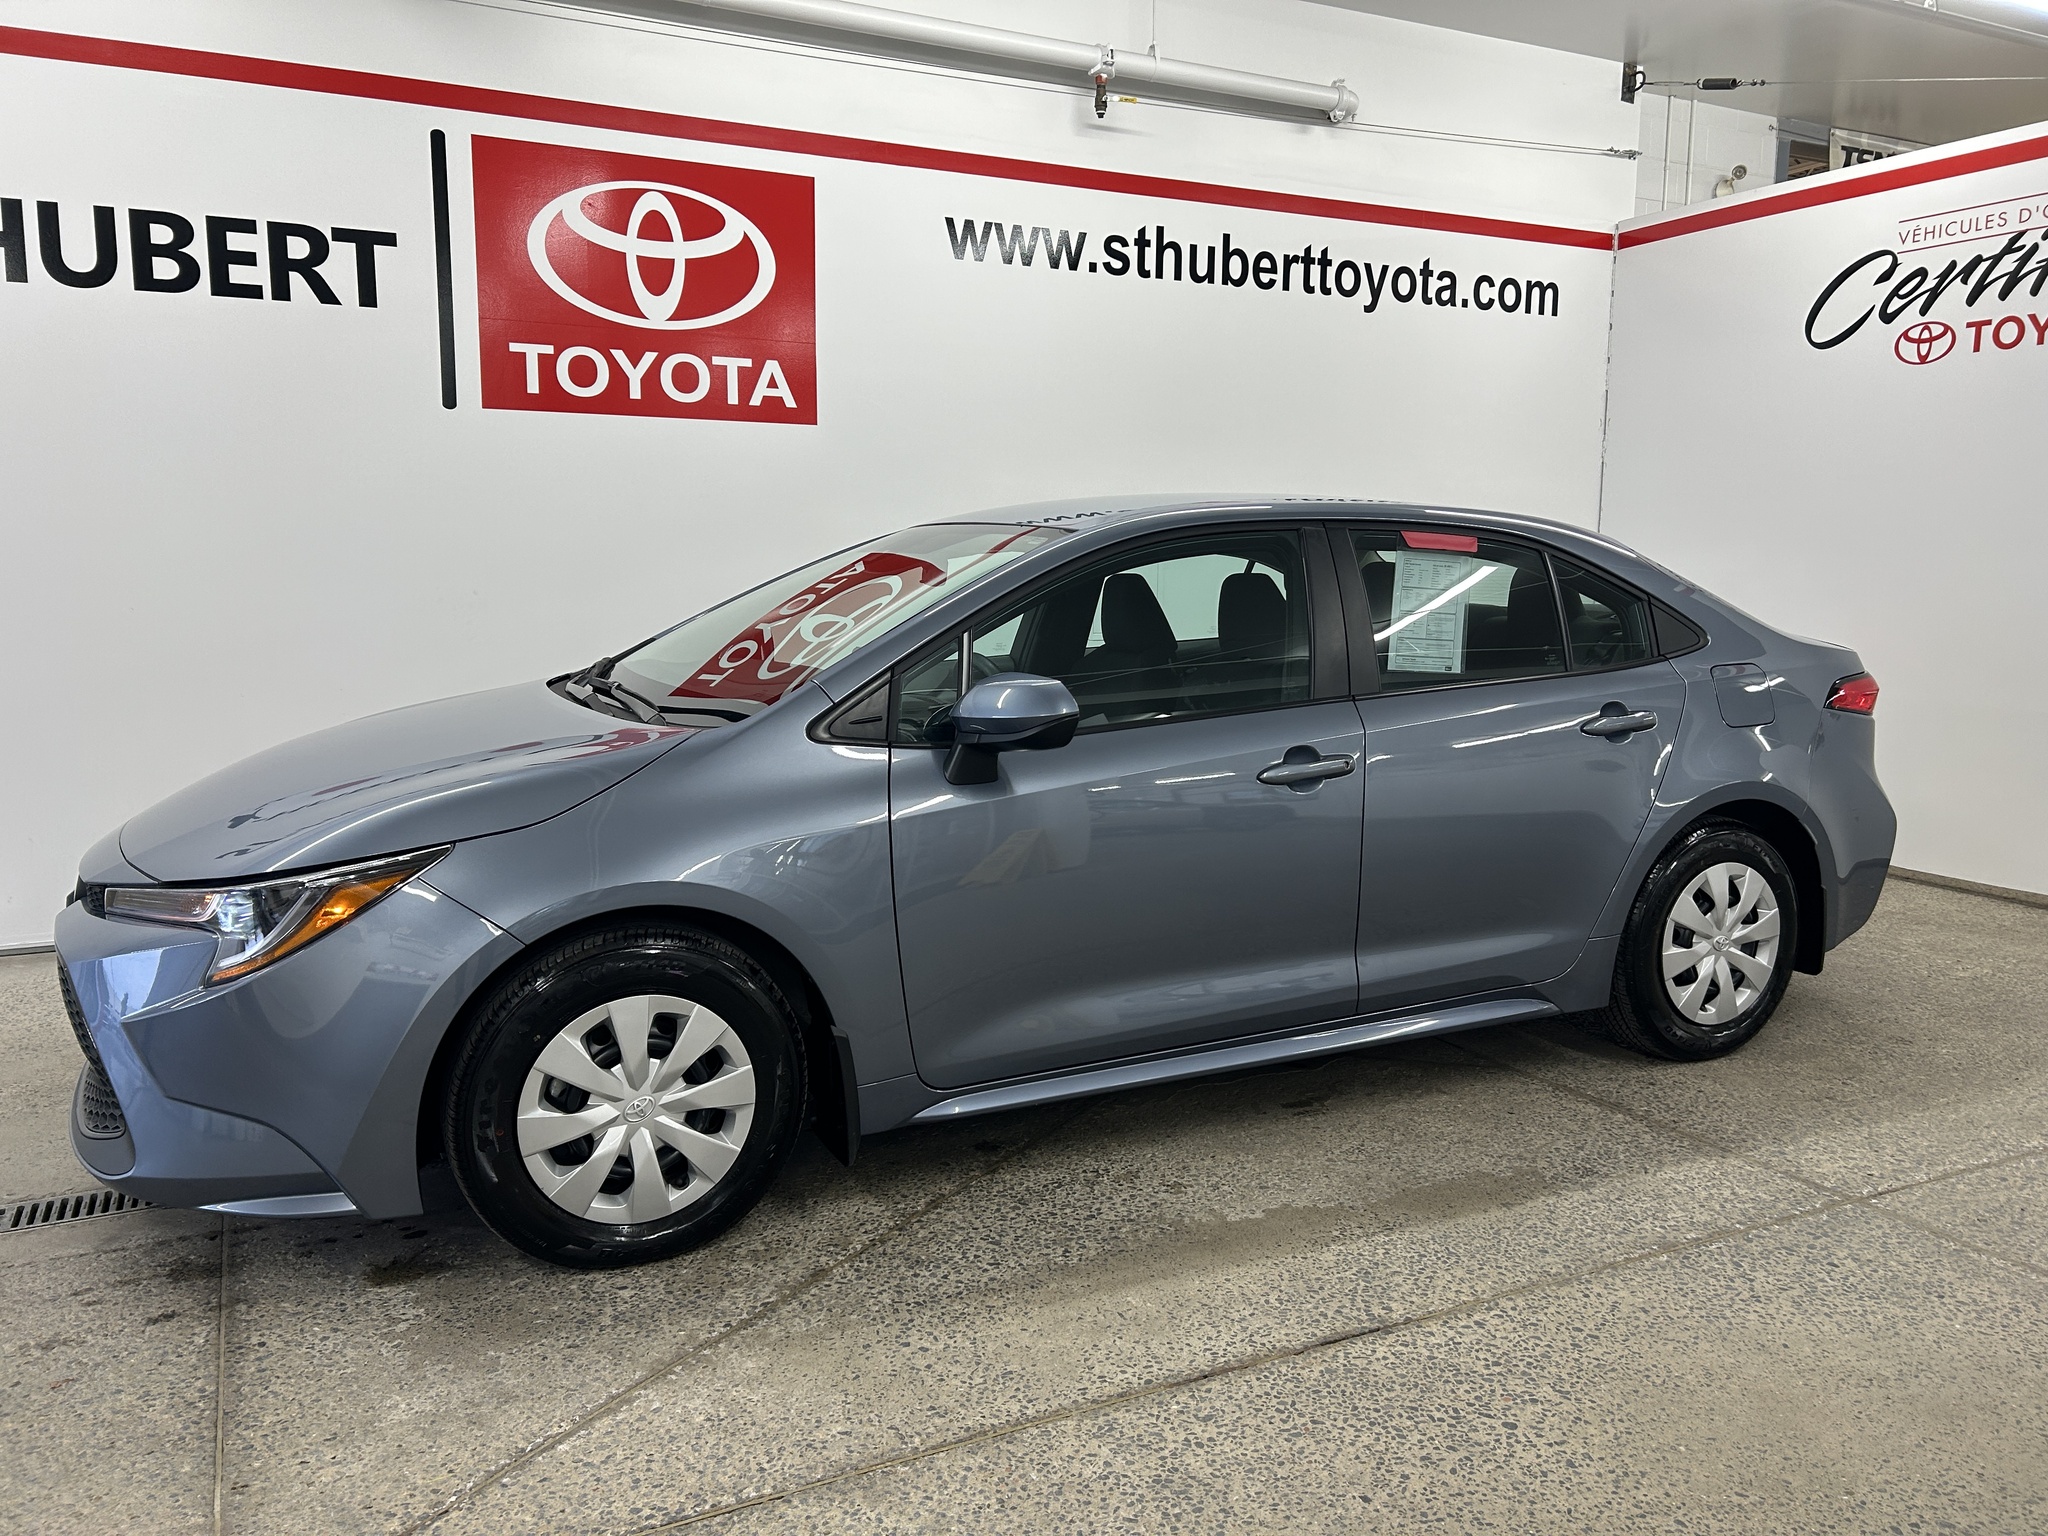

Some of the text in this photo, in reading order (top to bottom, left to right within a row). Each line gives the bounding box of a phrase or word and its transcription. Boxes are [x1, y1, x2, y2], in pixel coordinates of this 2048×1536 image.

[1898, 211, 2008, 246] VÉHICULES
[944, 216, 1560, 317] www.sthuberttoyota.com
[508, 342, 799, 409] TOYOTA
